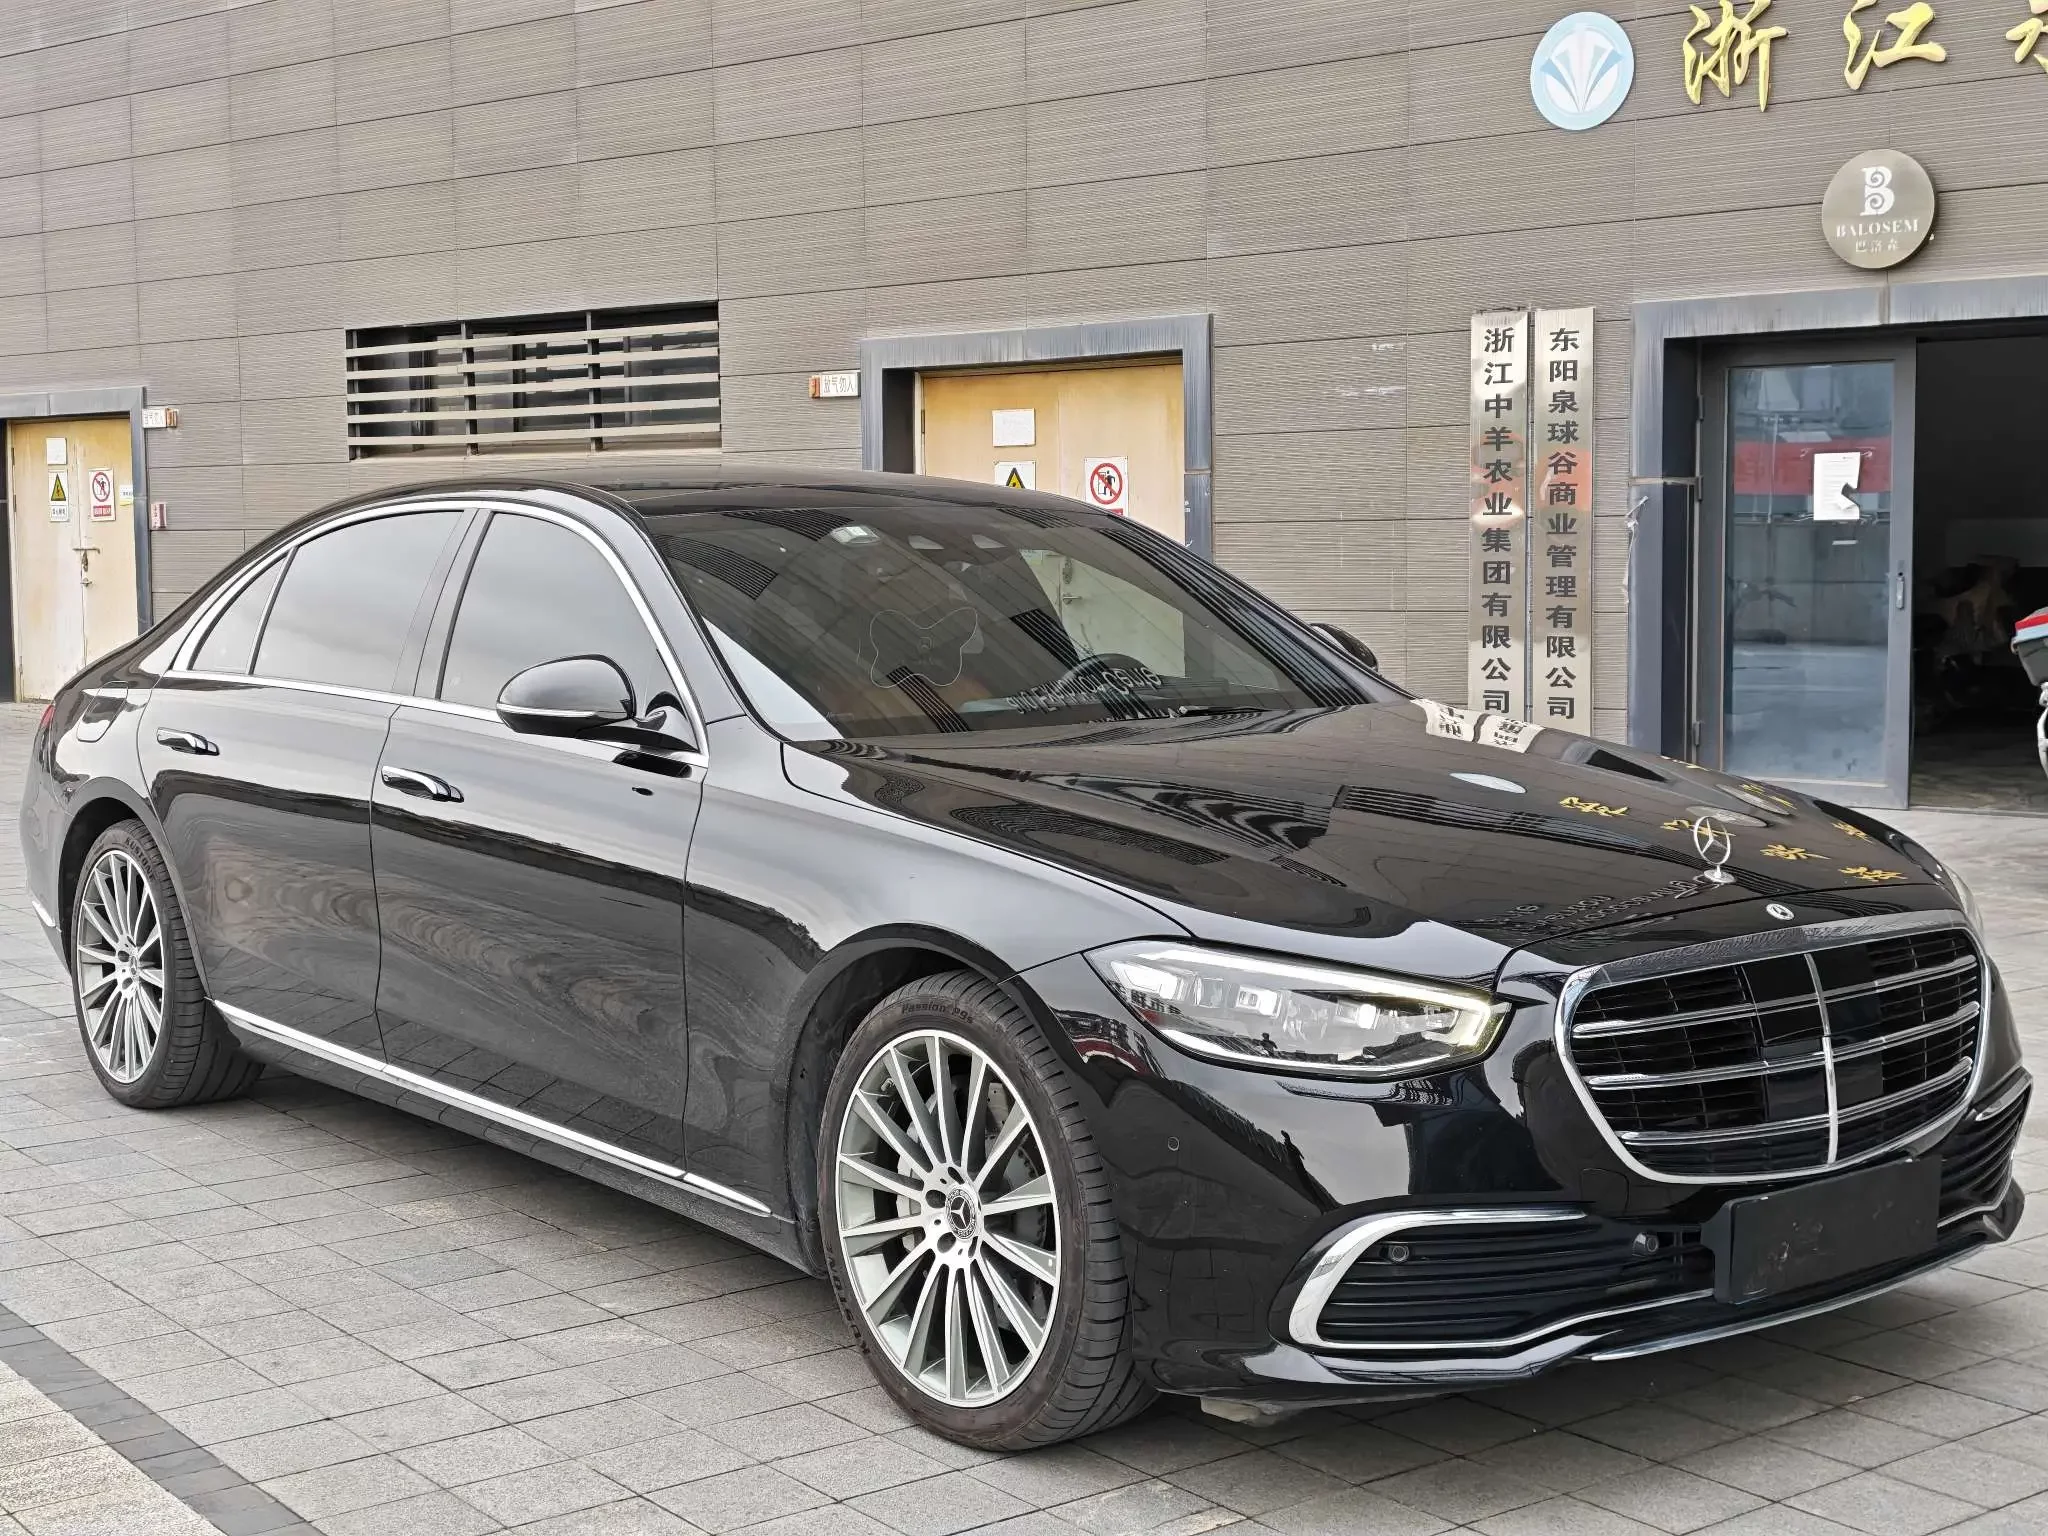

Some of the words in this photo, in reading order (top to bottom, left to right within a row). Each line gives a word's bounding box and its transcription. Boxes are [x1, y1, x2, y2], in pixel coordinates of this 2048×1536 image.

[1836, 218, 1920, 239] BALOSEM
[1481, 327, 1514, 715] 浙江中羊农业集团有限公司
[1546, 327, 1580, 720] 东阳泉球谷商业管理有限公司
